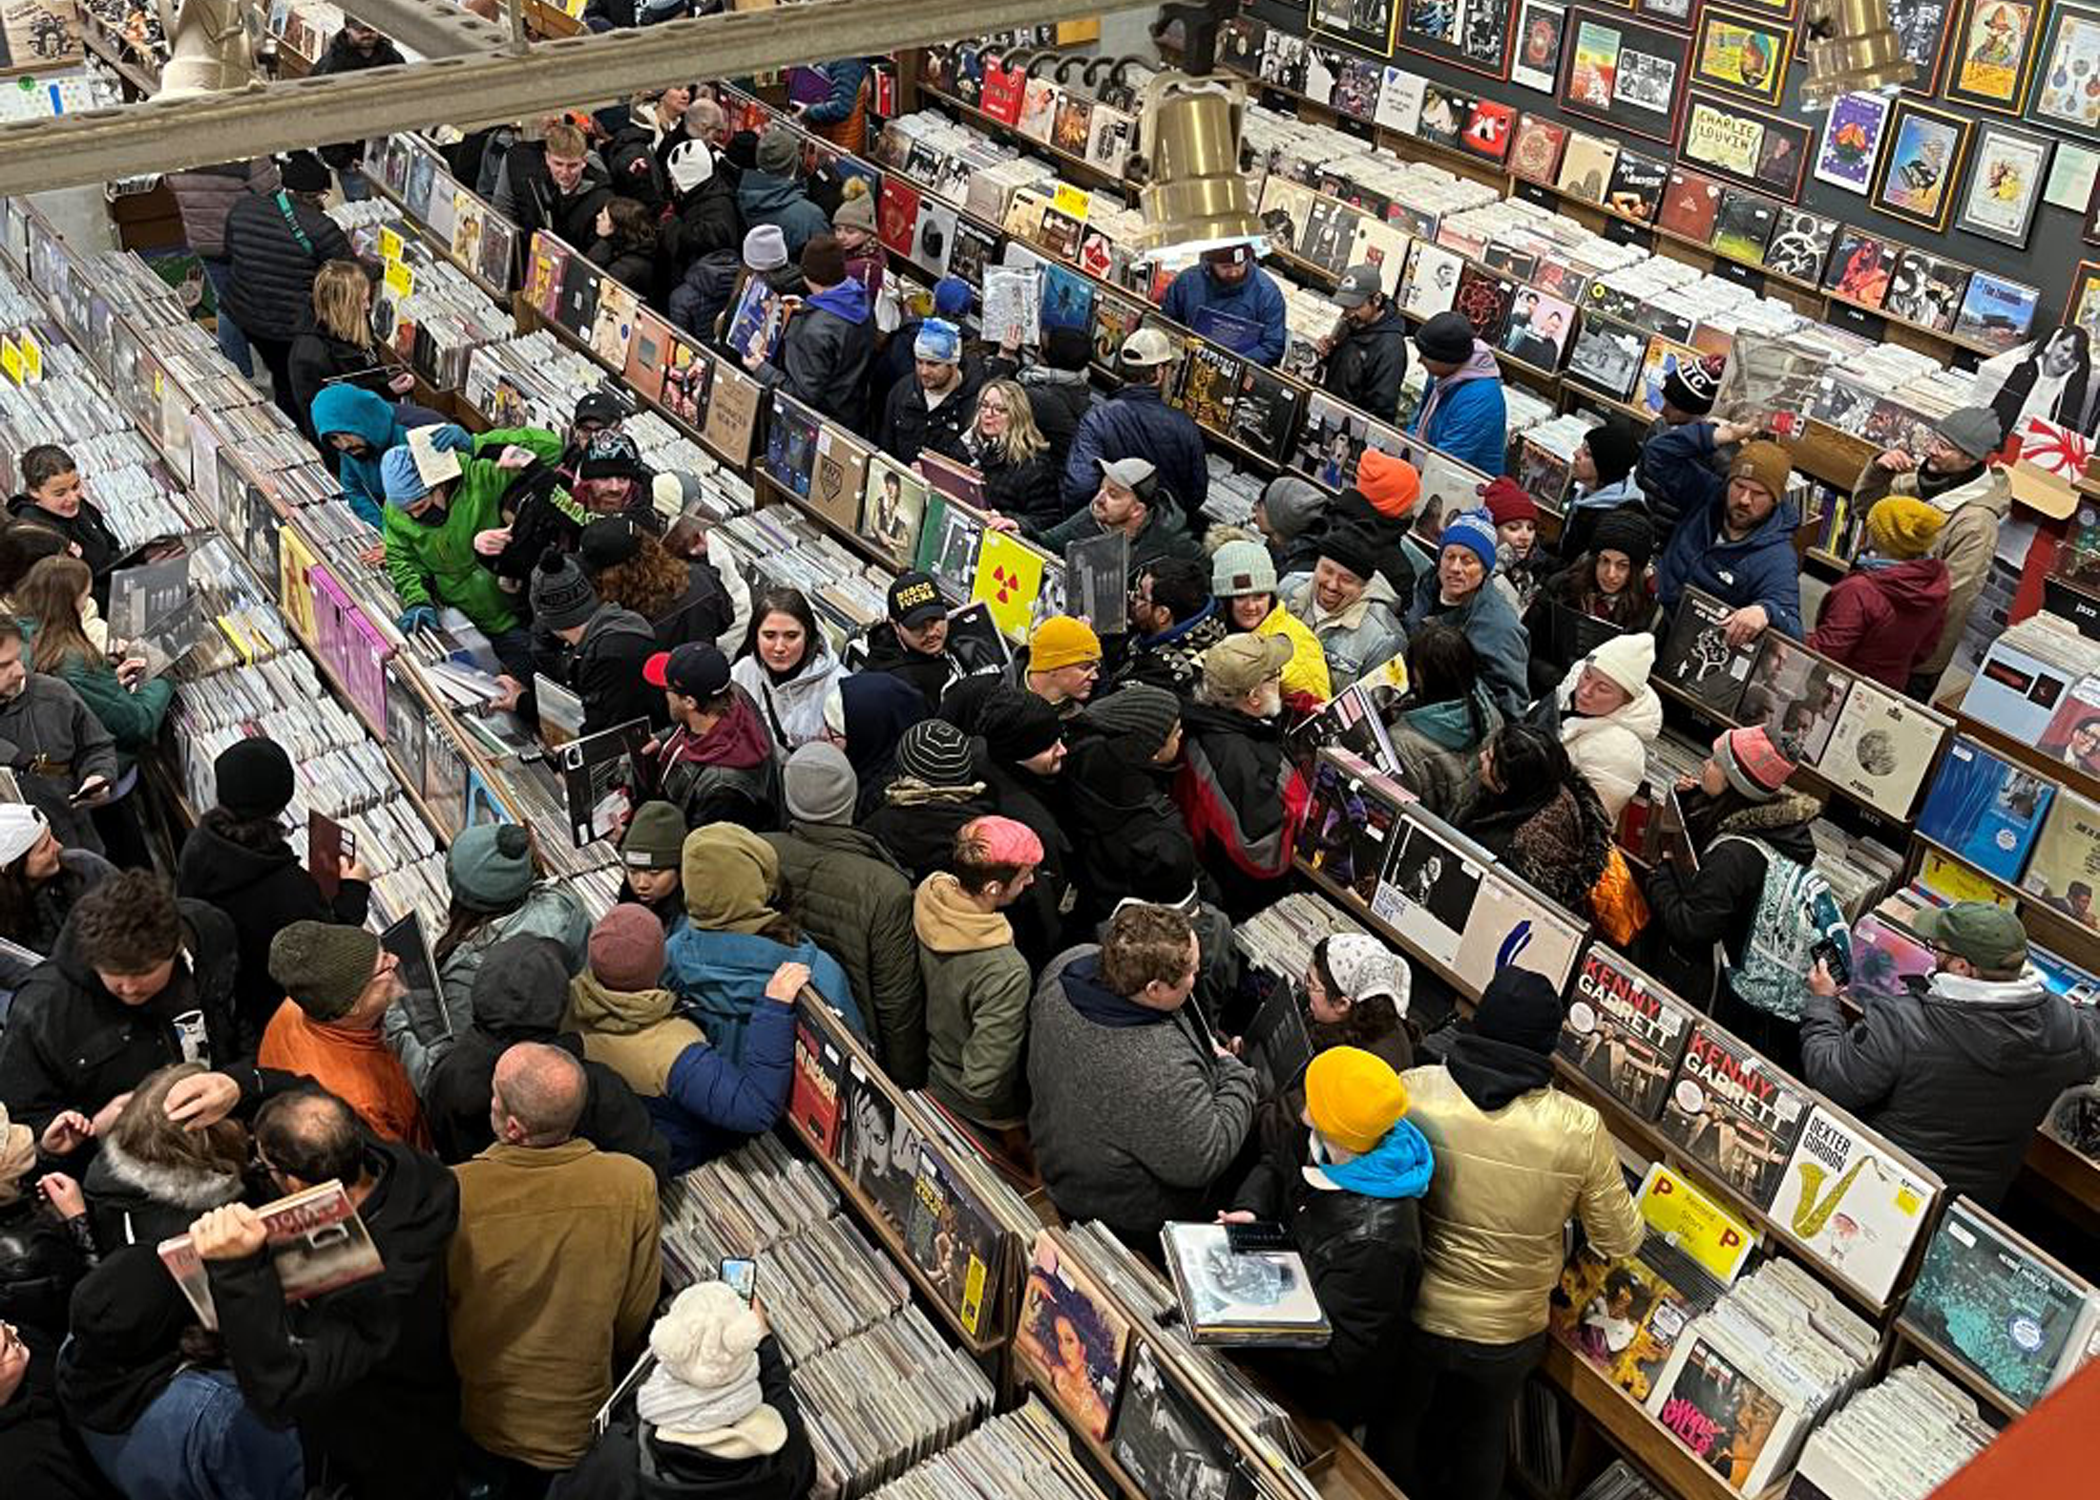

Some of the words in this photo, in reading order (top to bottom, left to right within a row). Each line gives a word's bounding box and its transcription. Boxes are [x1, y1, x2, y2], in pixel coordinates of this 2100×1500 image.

[1698, 110, 1755, 138] CHARLIE
[1699, 125, 1748, 150] LOUVIN
[2074, 602, 2098, 618] jazz
[1582, 954, 1661, 1019] KENNY
[1578, 973, 1673, 1048] GARRETT
[1688, 1030, 1774, 1100] KENNY
[1684, 1052, 1788, 1132] GARRETT
[1803, 1131, 1848, 1174] GORDON
[1808, 1116, 1852, 1156] DEXTER
